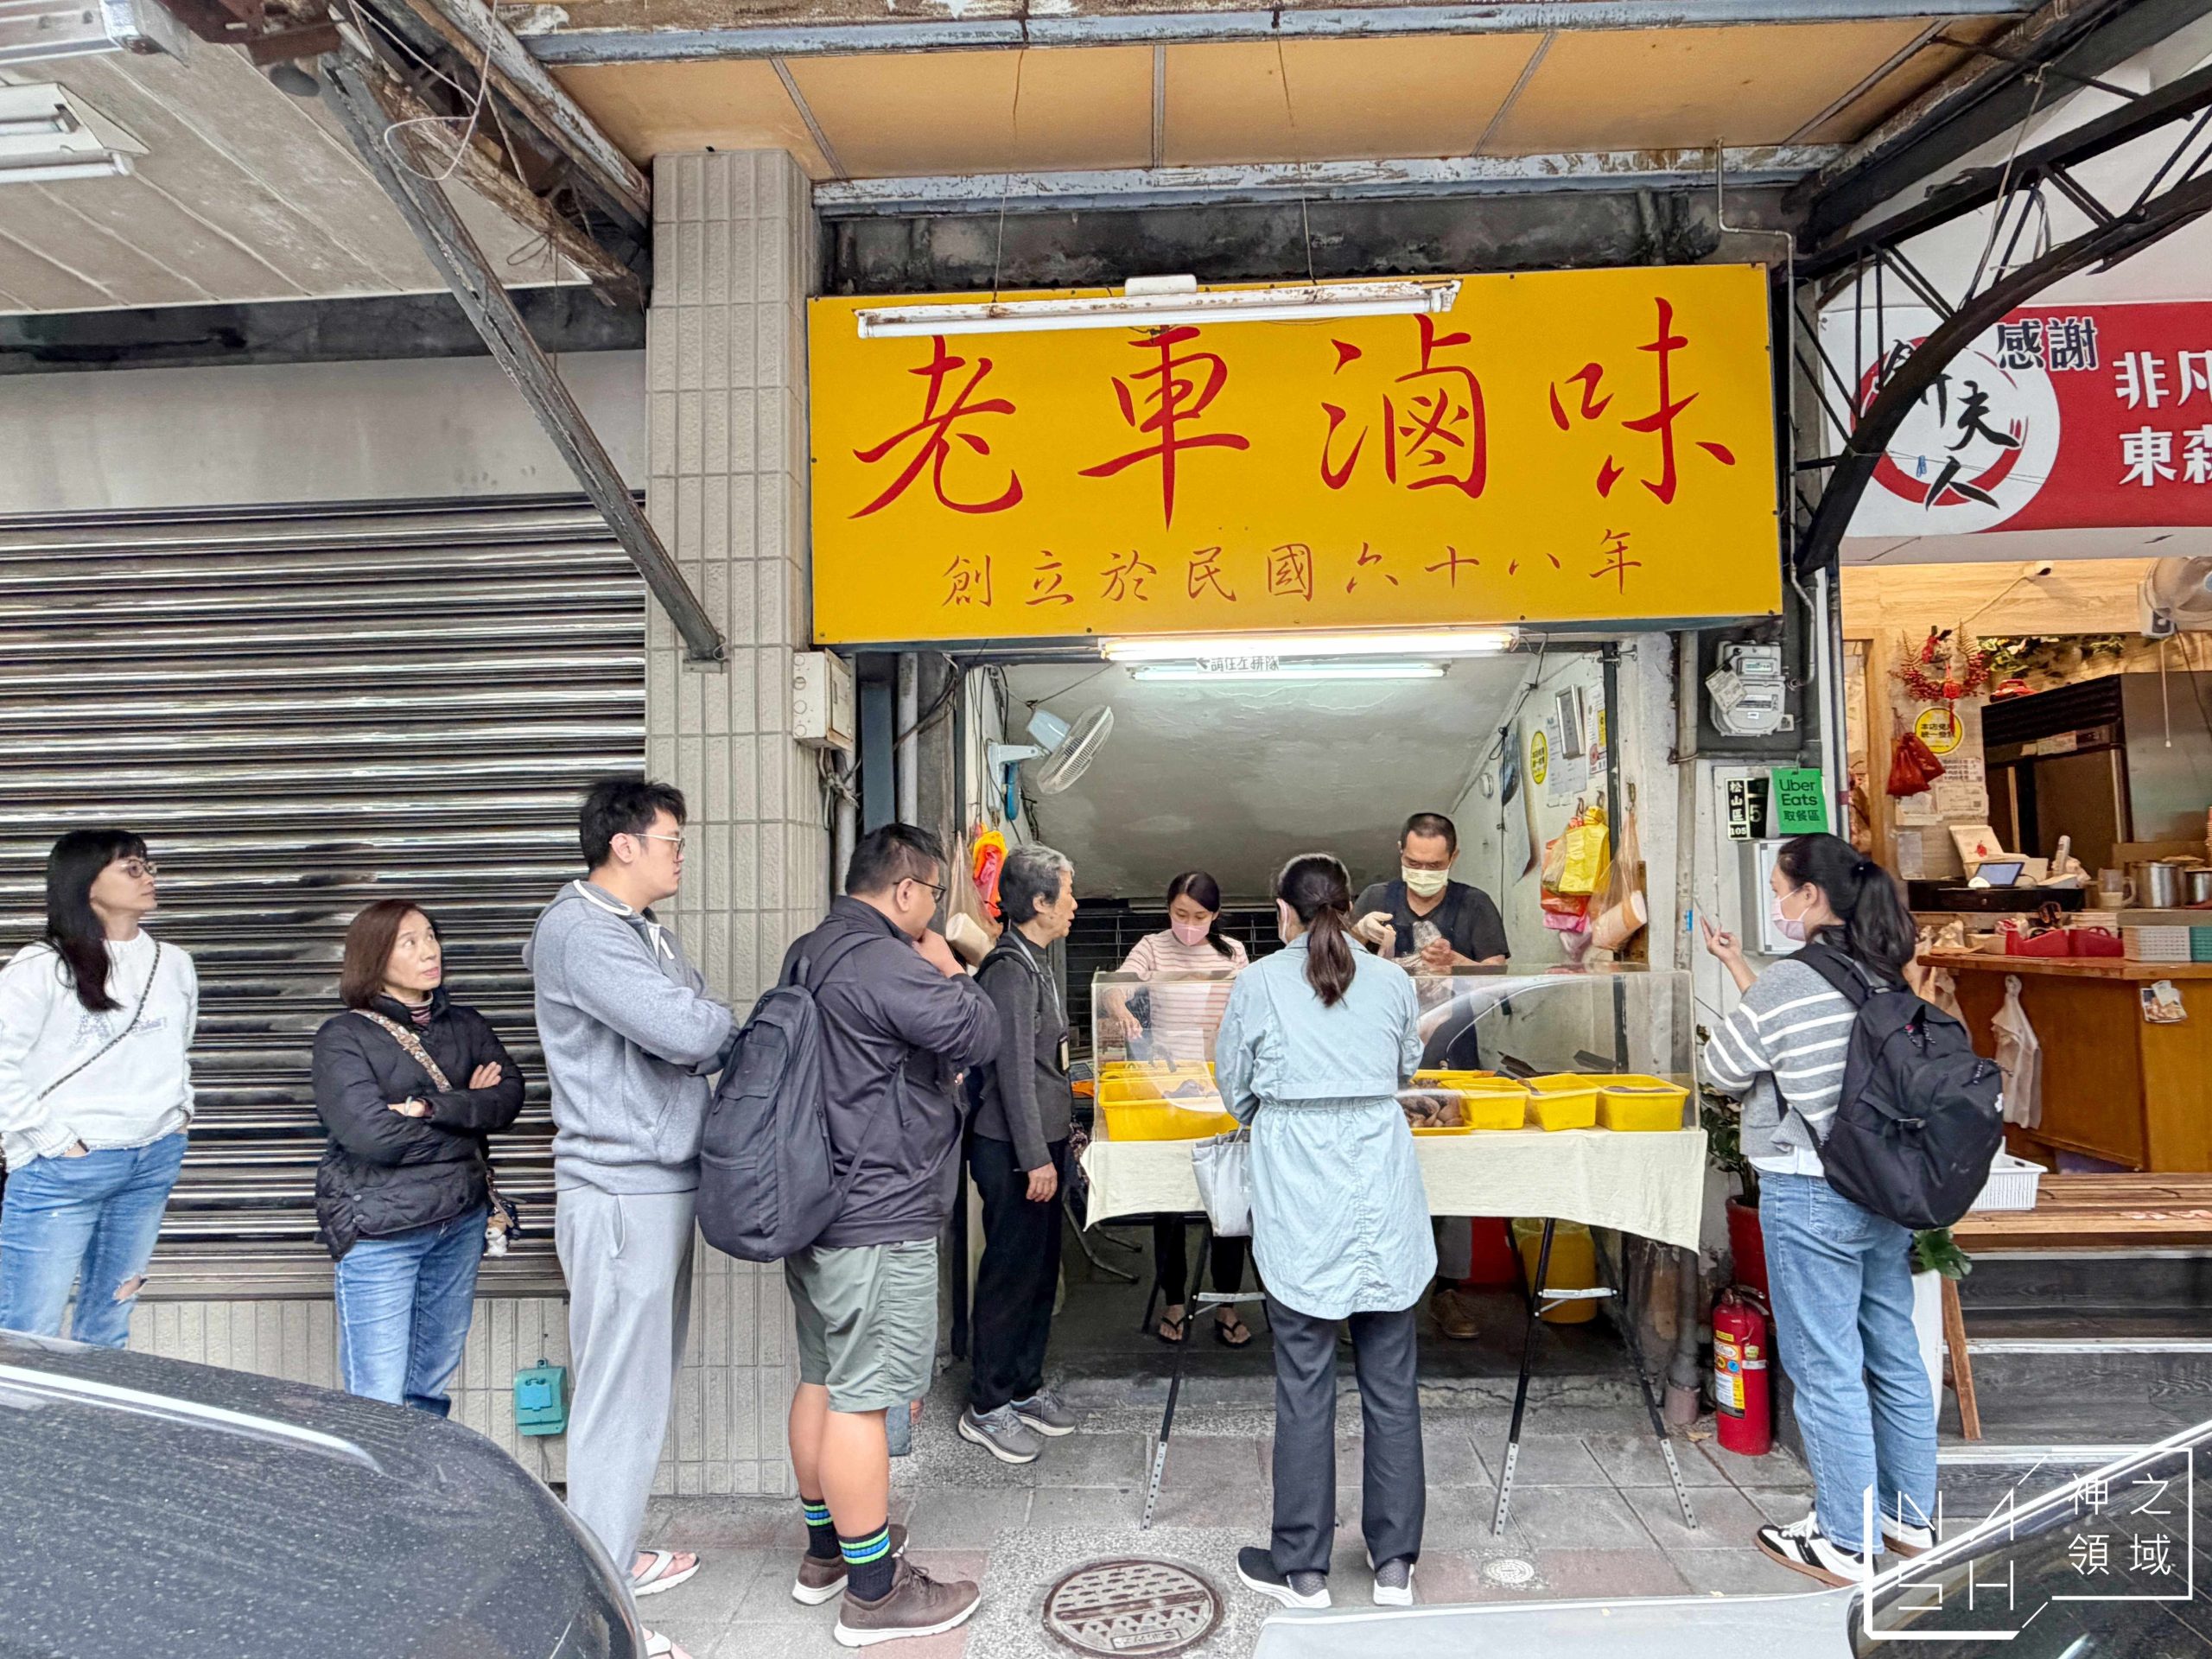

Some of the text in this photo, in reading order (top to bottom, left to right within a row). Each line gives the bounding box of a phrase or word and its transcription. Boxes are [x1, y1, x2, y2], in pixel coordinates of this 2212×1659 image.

[1996, 317, 2098, 371] 感謝
[849, 297, 1735, 531] 老車滷味
[941, 529, 1642, 607] 創立於民國六十八年
[1779, 779, 1815, 791] Uber
[1730, 782, 1744, 821] 松山區
[1782, 793, 1818, 805] Eats
[1783, 810, 1820, 821] 取餐區
[1731, 827, 1746, 836] 105
